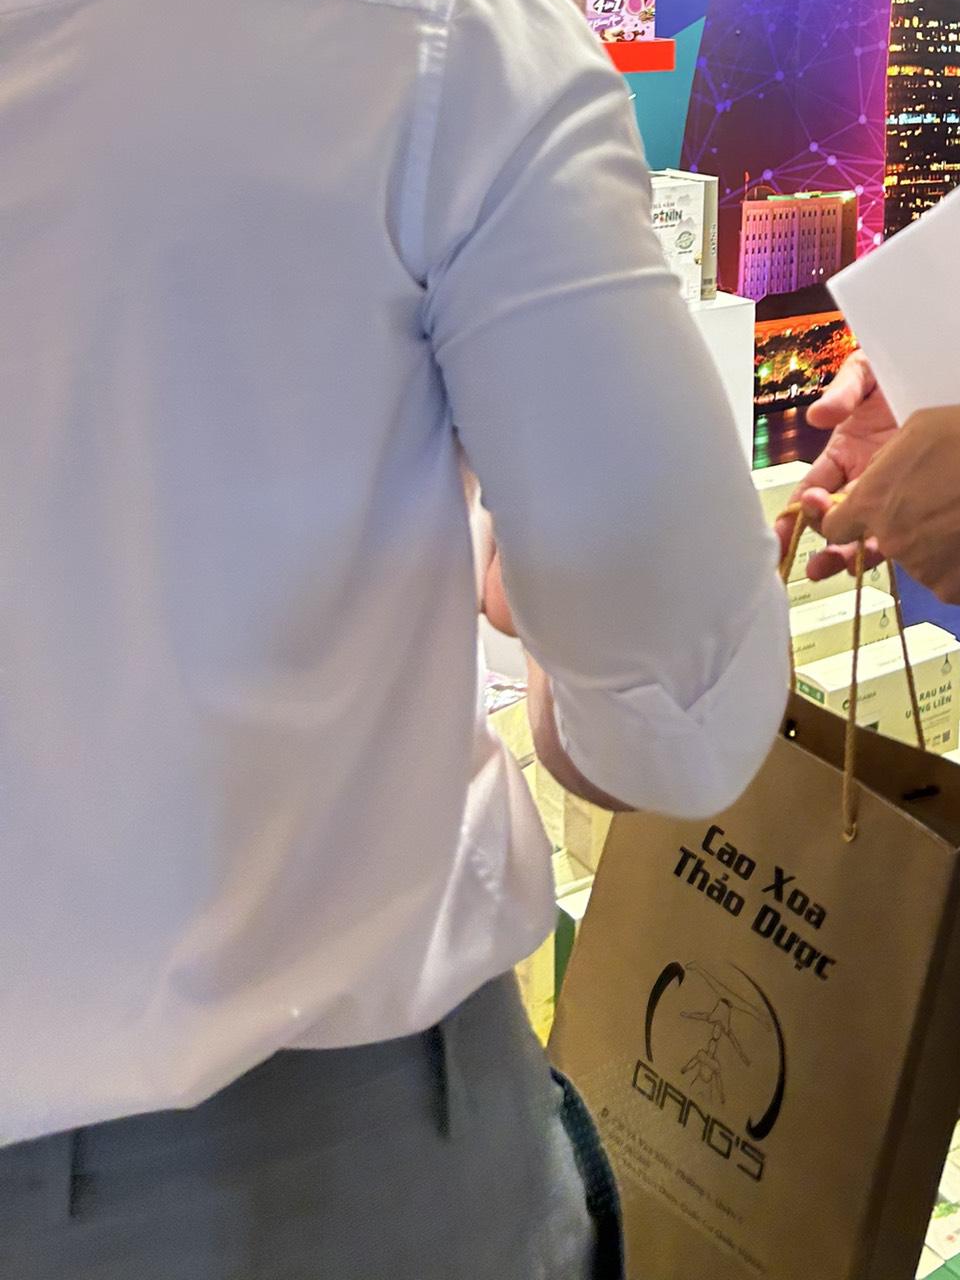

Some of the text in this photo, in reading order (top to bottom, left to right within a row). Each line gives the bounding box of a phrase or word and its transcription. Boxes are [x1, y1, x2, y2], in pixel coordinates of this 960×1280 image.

[905, 702, 931, 719] UNG
[919, 688, 937, 702] RAU
[701, 824, 828, 929] Cao Xoa
[673, 846, 837, 981] Thảo Dược
